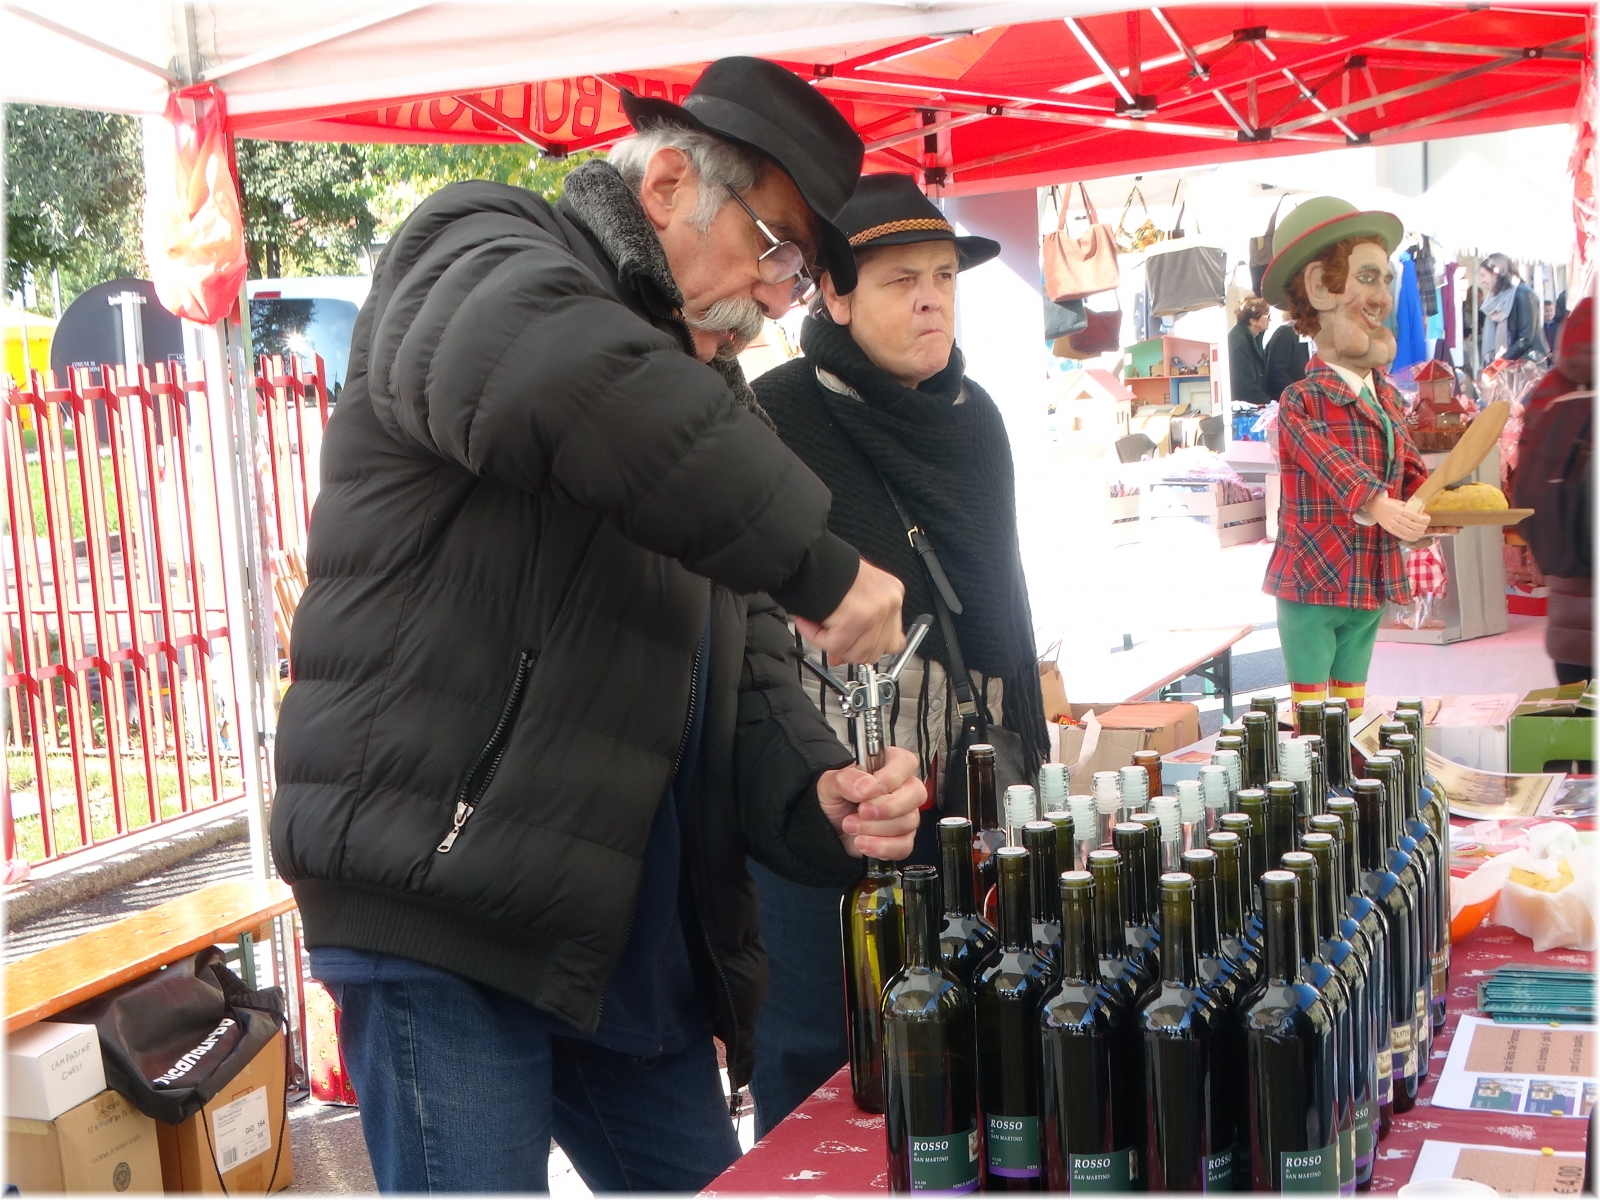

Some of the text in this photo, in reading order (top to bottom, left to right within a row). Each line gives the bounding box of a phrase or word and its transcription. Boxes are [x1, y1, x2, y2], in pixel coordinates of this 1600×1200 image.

[1431, 955, 1445, 965] BIAN
[51, 1042, 91, 1071] LAMPADINE
[1355, 1107, 1369, 1120] SSO
[990, 1118, 1023, 1130] ROSSO
[87, 1126, 93, 1134] 12
[913, 1141, 949, 1151] ROSSO
[1074, 1158, 1111, 1169] ROSSO
[1208, 1152, 1233, 1170] ROSSO
[1285, 1155, 1322, 1167] ROSSO
[1086, 1173, 1110, 1181] MARTINO
[1208, 1174, 1218, 1182] SAN
[1298, 1170, 1322, 1180] MARTINO
